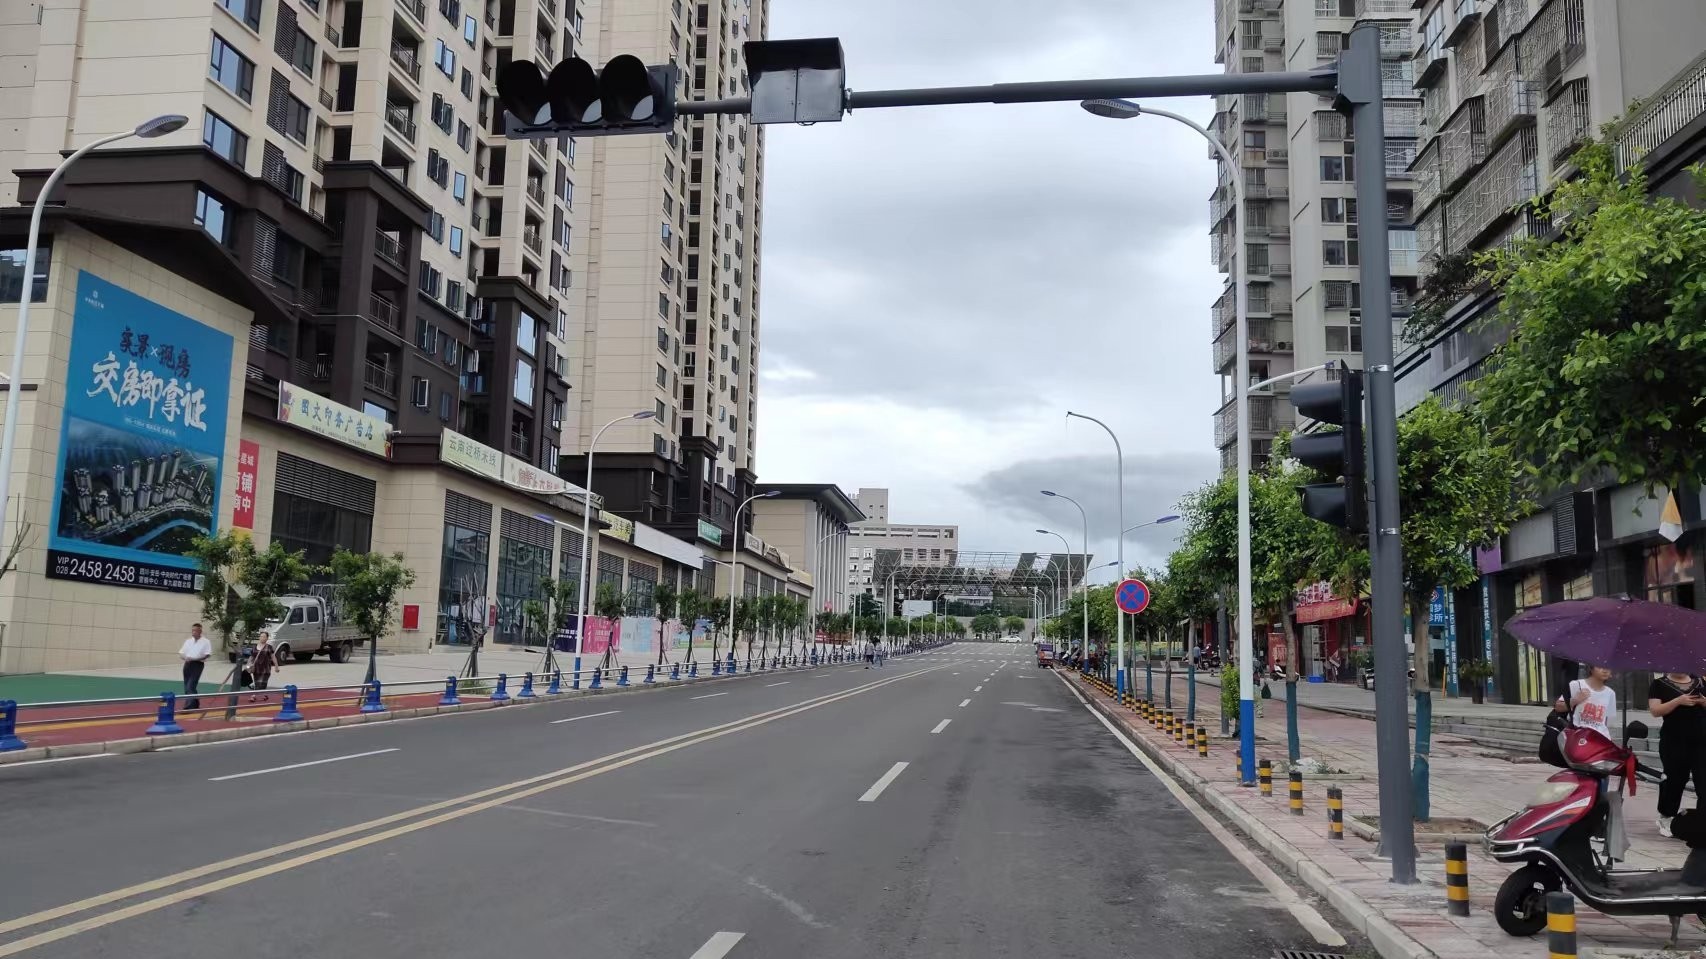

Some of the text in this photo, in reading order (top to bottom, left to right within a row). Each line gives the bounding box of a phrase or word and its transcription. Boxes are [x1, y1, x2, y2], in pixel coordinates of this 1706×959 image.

[86, 351, 207, 432] 交房即拿证
[301, 398, 373, 440] 图文印务广告店
[449, 435, 497, 466] 云南过桥米线
[56, 566, 69, 575] 028
[57, 556, 70, 565] VIP
[70, 558, 135, 582] 2458 2458
